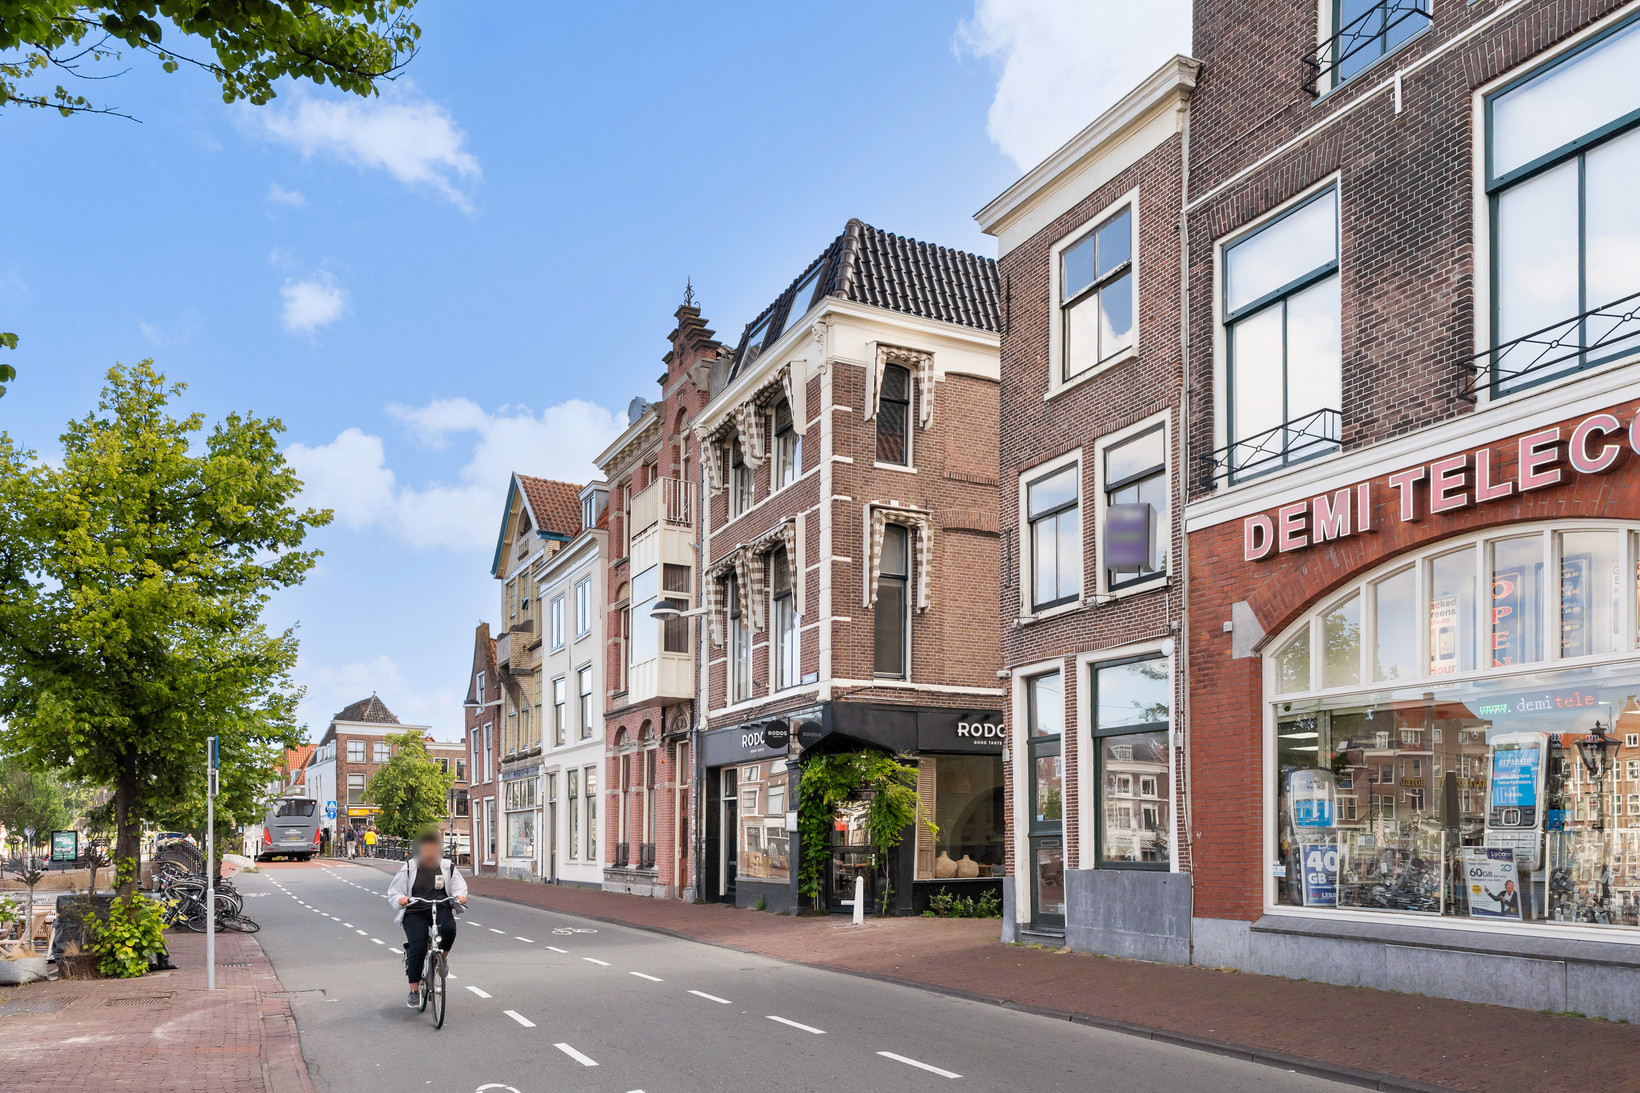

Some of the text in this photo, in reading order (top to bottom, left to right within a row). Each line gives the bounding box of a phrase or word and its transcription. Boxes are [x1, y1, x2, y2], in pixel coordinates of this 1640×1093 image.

[1244, 408, 1640, 561] DEMI TELEC
[1430, 598, 1456, 610] acked
[1431, 608, 1456, 618] reens
[1516, 695, 1552, 712] demi
[1554, 691, 1594, 709] tele
[958, 722, 1004, 738] RODO
[742, 731, 765, 748] RODO
[1307, 851, 1338, 872] 40
[1308, 873, 1326, 884] GB
